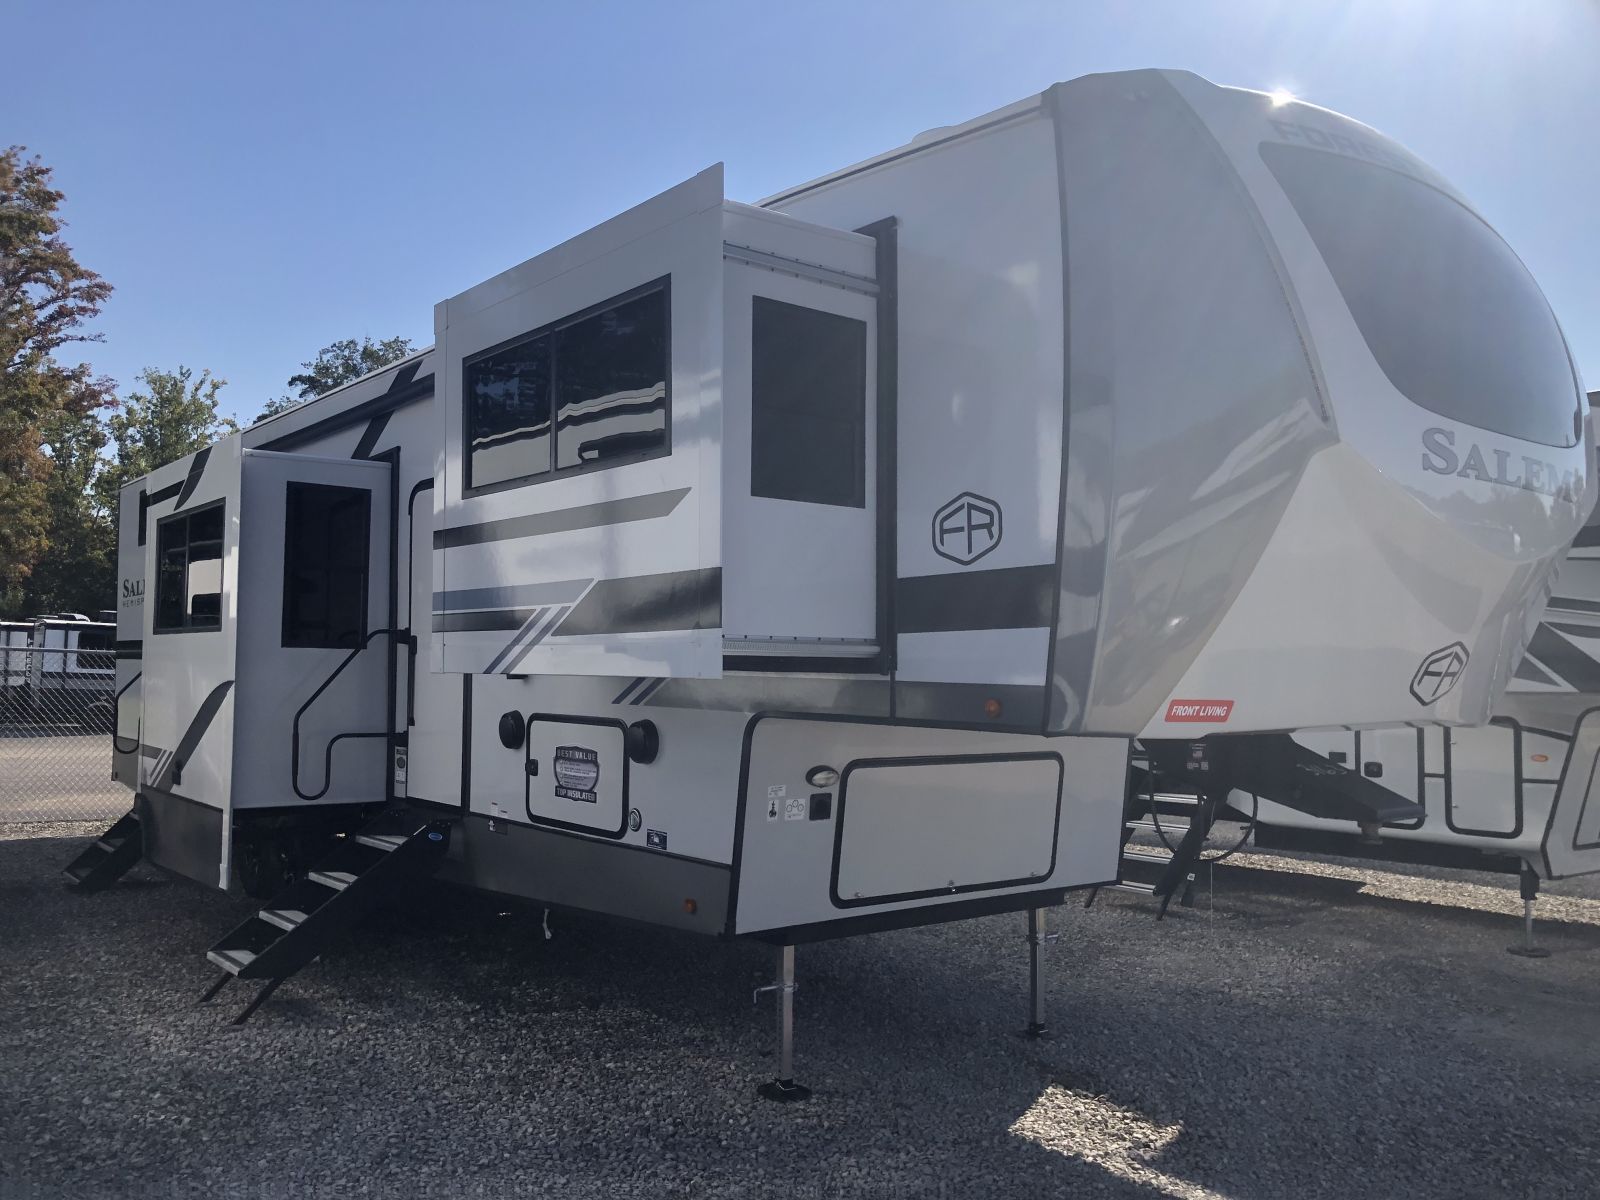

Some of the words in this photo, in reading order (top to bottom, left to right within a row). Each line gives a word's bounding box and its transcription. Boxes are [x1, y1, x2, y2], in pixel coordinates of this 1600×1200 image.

[1422, 427, 1574, 503] SALEM
[1171, 705, 1200, 716] FRONT
[1199, 706, 1228, 717] LIVING
[575, 751, 596, 760] VALUE
[567, 789, 596, 801] INSULATED
